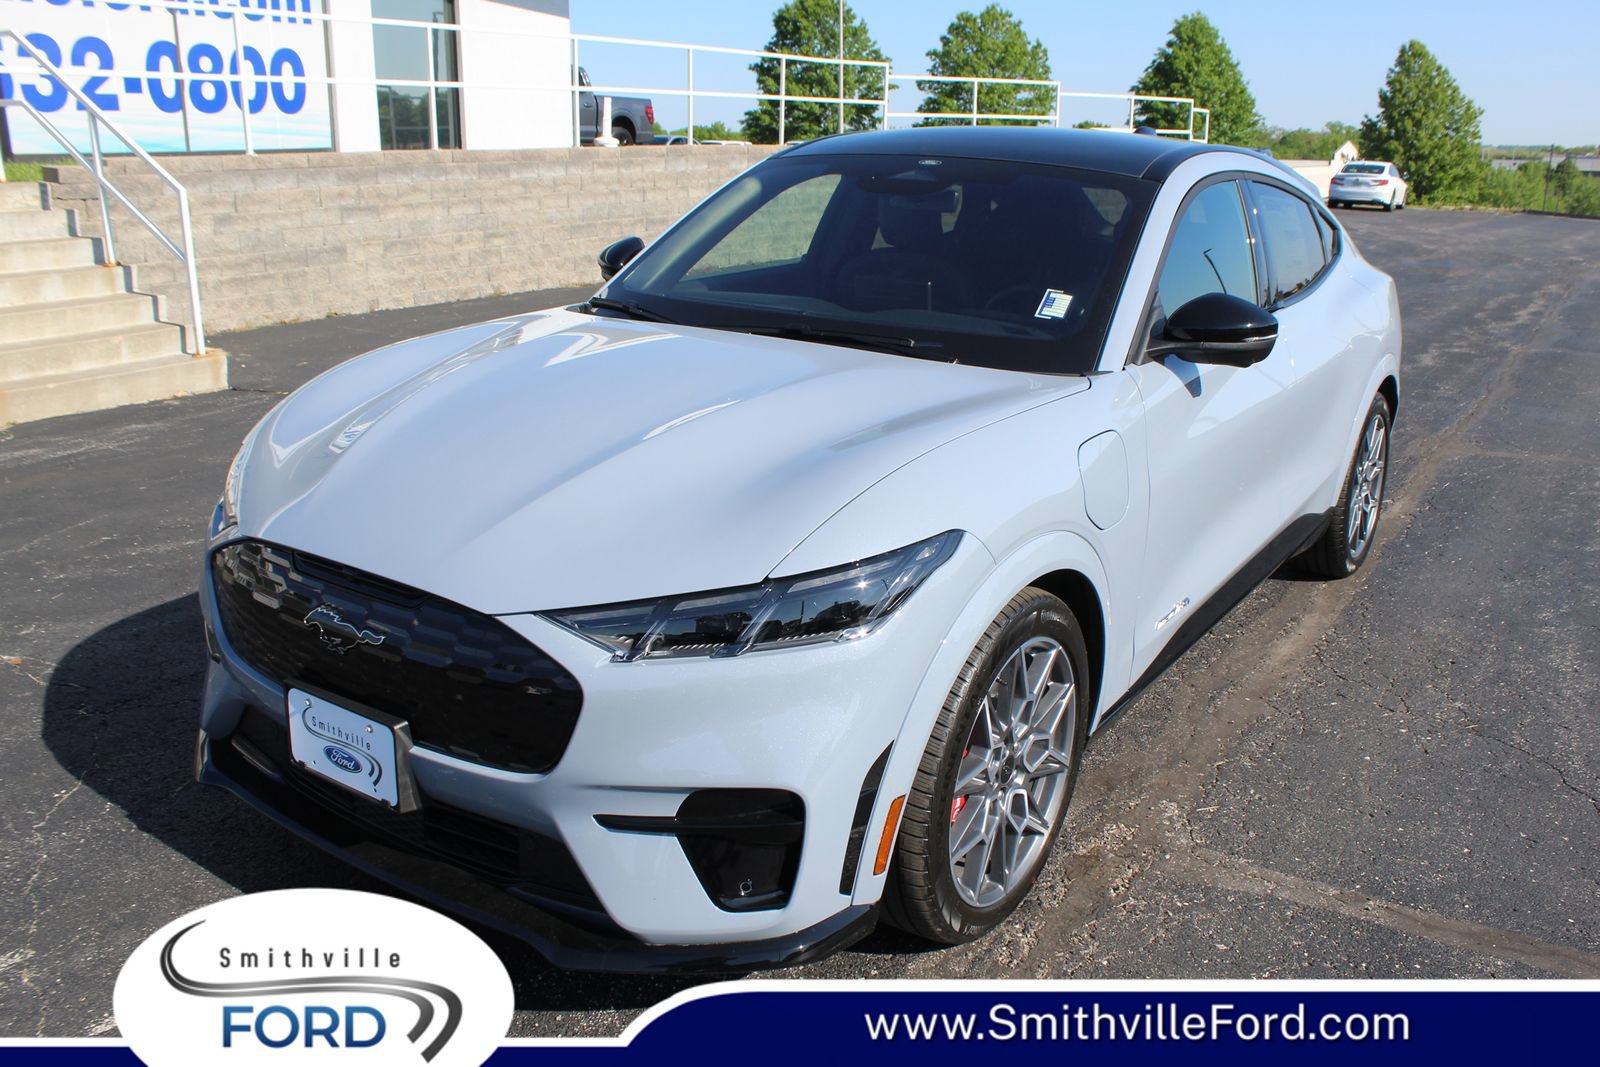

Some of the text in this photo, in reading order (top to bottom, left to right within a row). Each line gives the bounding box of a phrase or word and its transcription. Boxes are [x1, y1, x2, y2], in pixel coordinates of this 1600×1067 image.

[0, 32, 306, 114] 32-0800
[311, 716, 371, 751] Smithville
[329, 749, 356, 770] Ford
